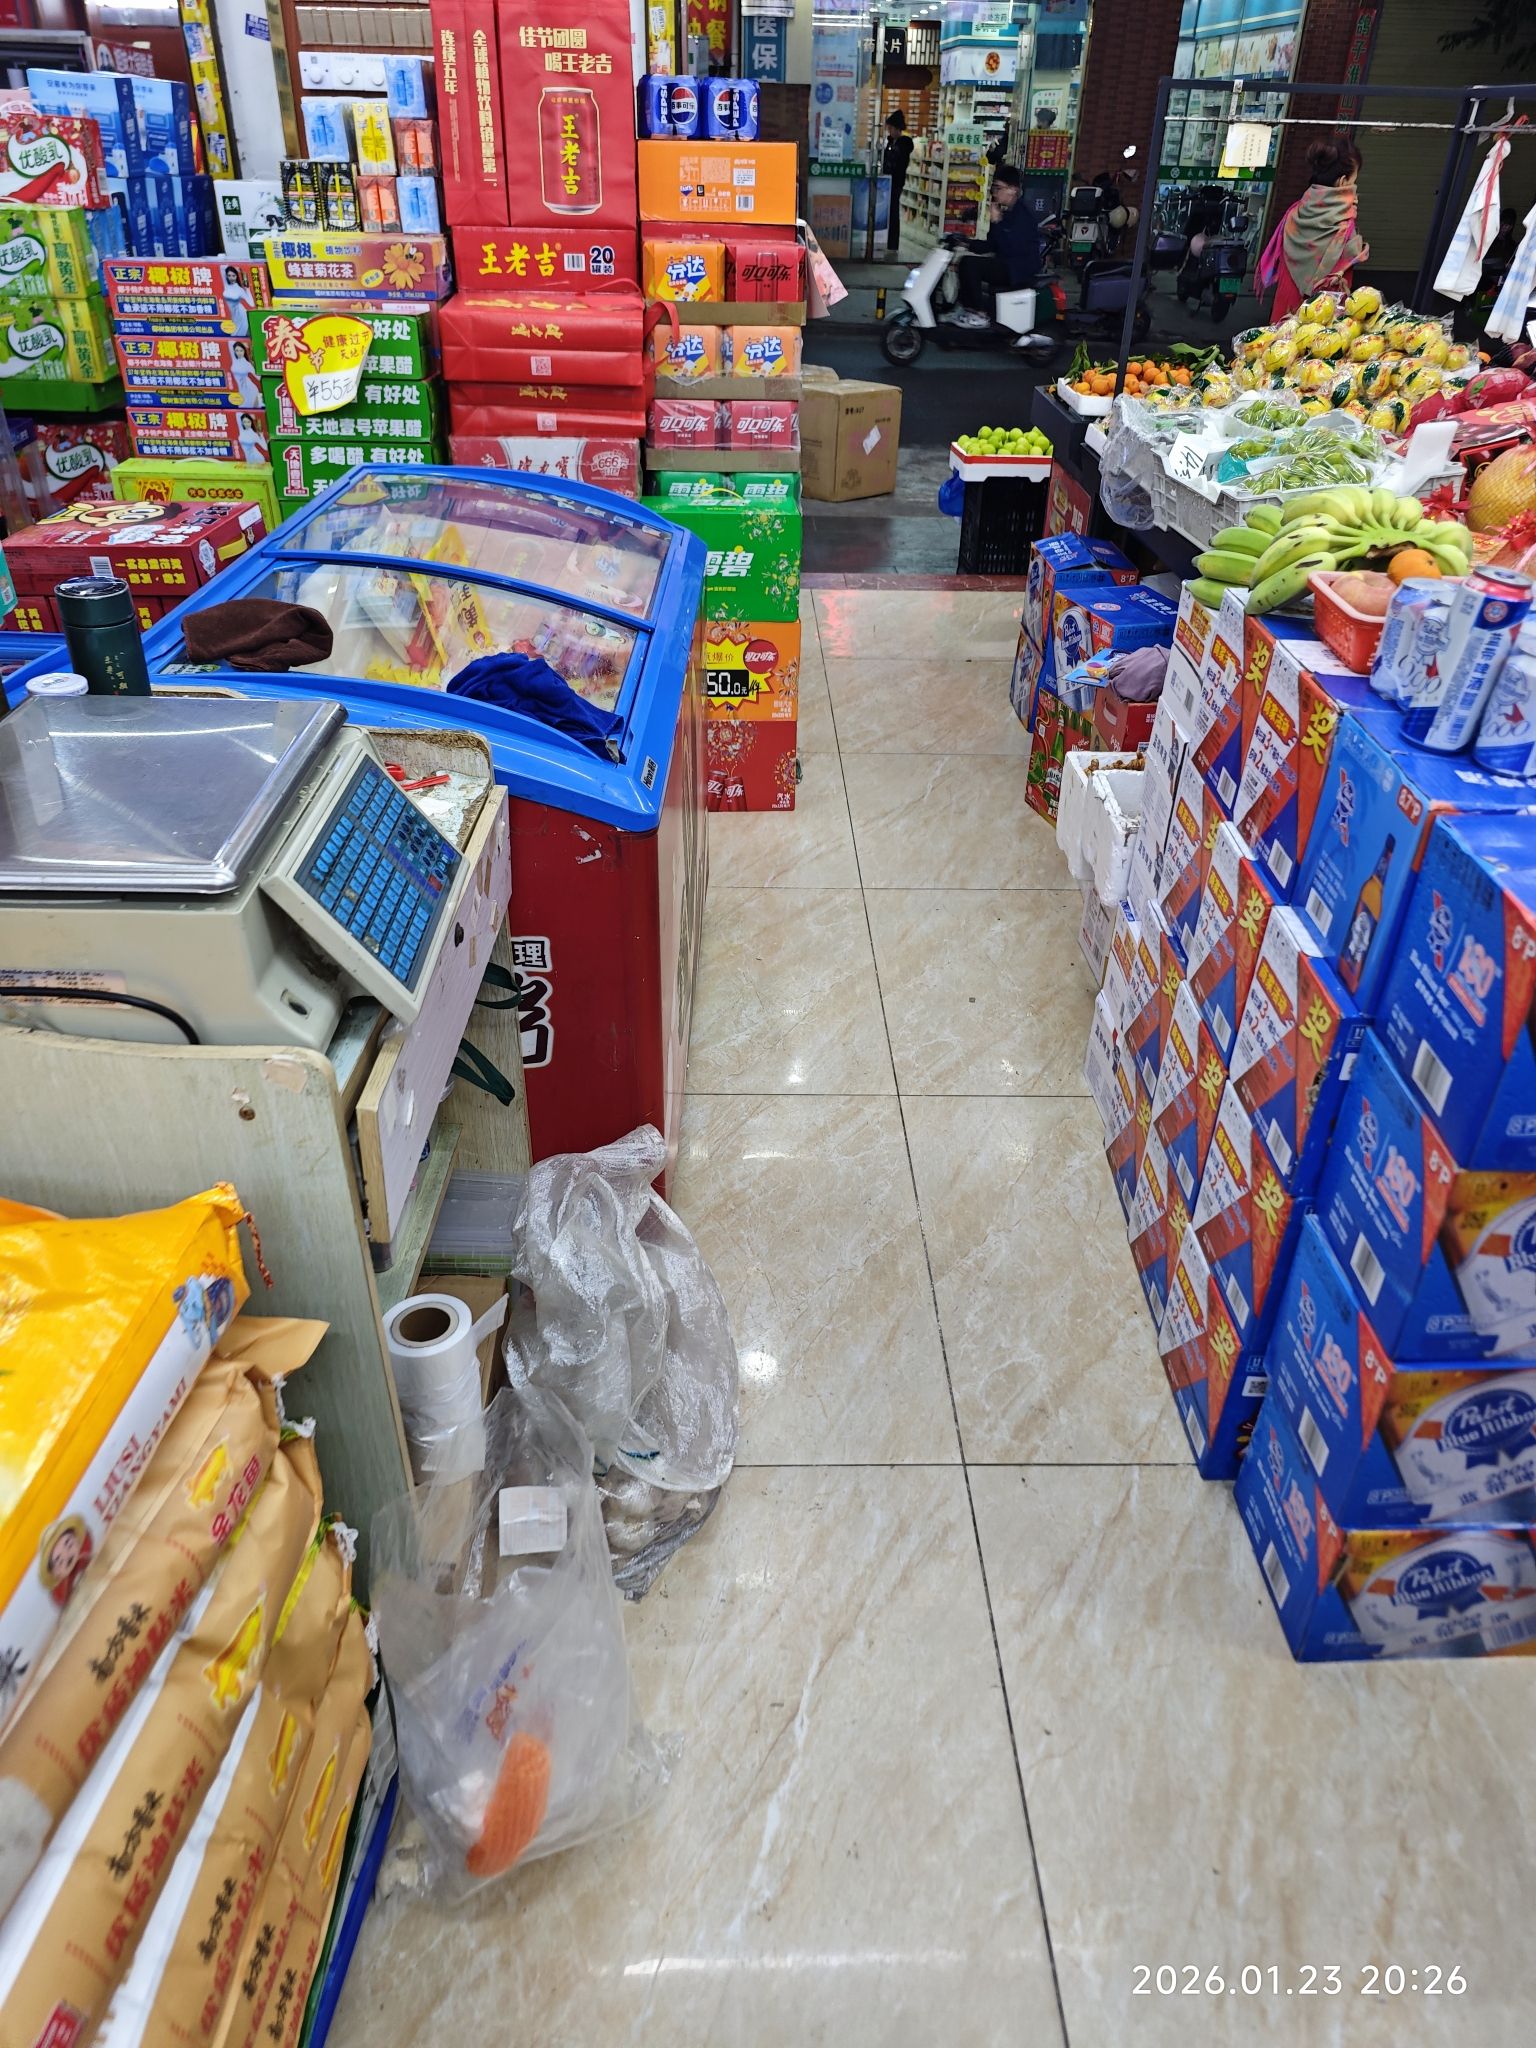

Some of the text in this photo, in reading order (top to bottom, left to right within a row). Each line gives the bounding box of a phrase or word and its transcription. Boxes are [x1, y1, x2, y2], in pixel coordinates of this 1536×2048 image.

[519, 26, 587, 49] 佳节团圆
[441, 29, 458, 95] 连续五年
[544, 52, 613, 75] 喝王老吉
[660, 86, 668, 124] PEPSI
[732, 89, 740, 127] PEPSI
[947, 132, 981, 146] 医保专区
[19, 141, 63, 169] 优酸乳
[559, 114, 581, 195] 王老吉
[0, 239, 39, 267] 优酸乳
[281, 241, 313, 259] 椰树
[478, 242, 558, 277] 王老吉
[590, 247, 614, 265] 20
[114, 267, 142, 282] 正宗
[147, 266, 214, 288] 椰树牌
[287, 262, 354, 279] 蜂蜜菊花茶
[590, 265, 613, 275] 罐装
[742, 264, 793, 283] 可口可乐
[18, 328, 58, 352] 优酸乳
[124, 341, 151, 354] 正宗
[157, 340, 222, 360] 椰树牌
[322, 331, 370, 349] 健康过节
[364, 384, 421, 406] 有好处
[134, 412, 160, 425] 正宗
[166, 412, 228, 430] 椰树牌
[305, 417, 422, 437] 天地壹号苹果醋
[659, 415, 711, 433] 可口可乐
[736, 415, 788, 434] 可口可乐
[56, 447, 98, 474] 优酸乳
[310, 446, 425, 466] 多喝醋 有好处
[1438, 1430, 1480, 1453] Blue
[1431, 1566, 1492, 1596] Ribbon
